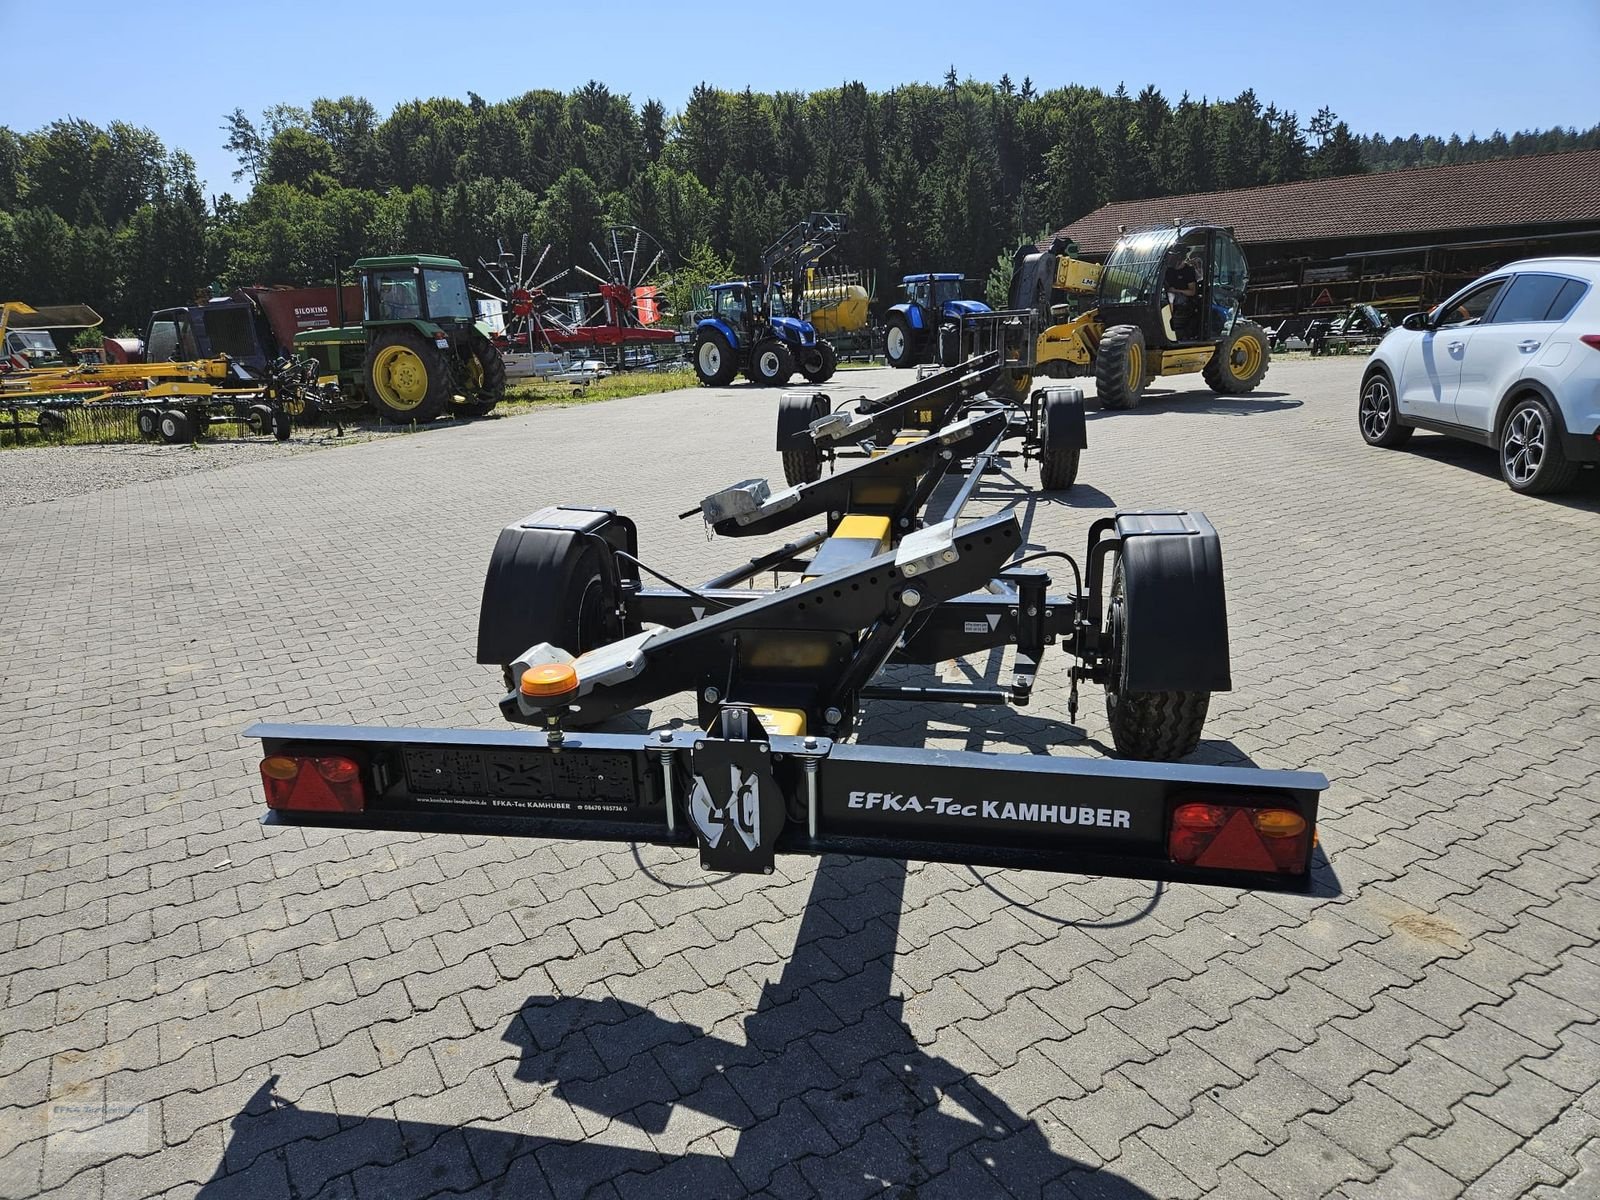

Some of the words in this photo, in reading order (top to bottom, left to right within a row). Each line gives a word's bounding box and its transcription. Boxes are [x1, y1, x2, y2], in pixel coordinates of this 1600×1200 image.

[294, 306, 328, 315] SILOKING
[492, 800, 526, 808] EFKA-Tec
[527, 801, 571, 810] KAMHUBER
[847, 791, 977, 818] EFKA-Tec
[981, 800, 1131, 829] KAMHUBER
